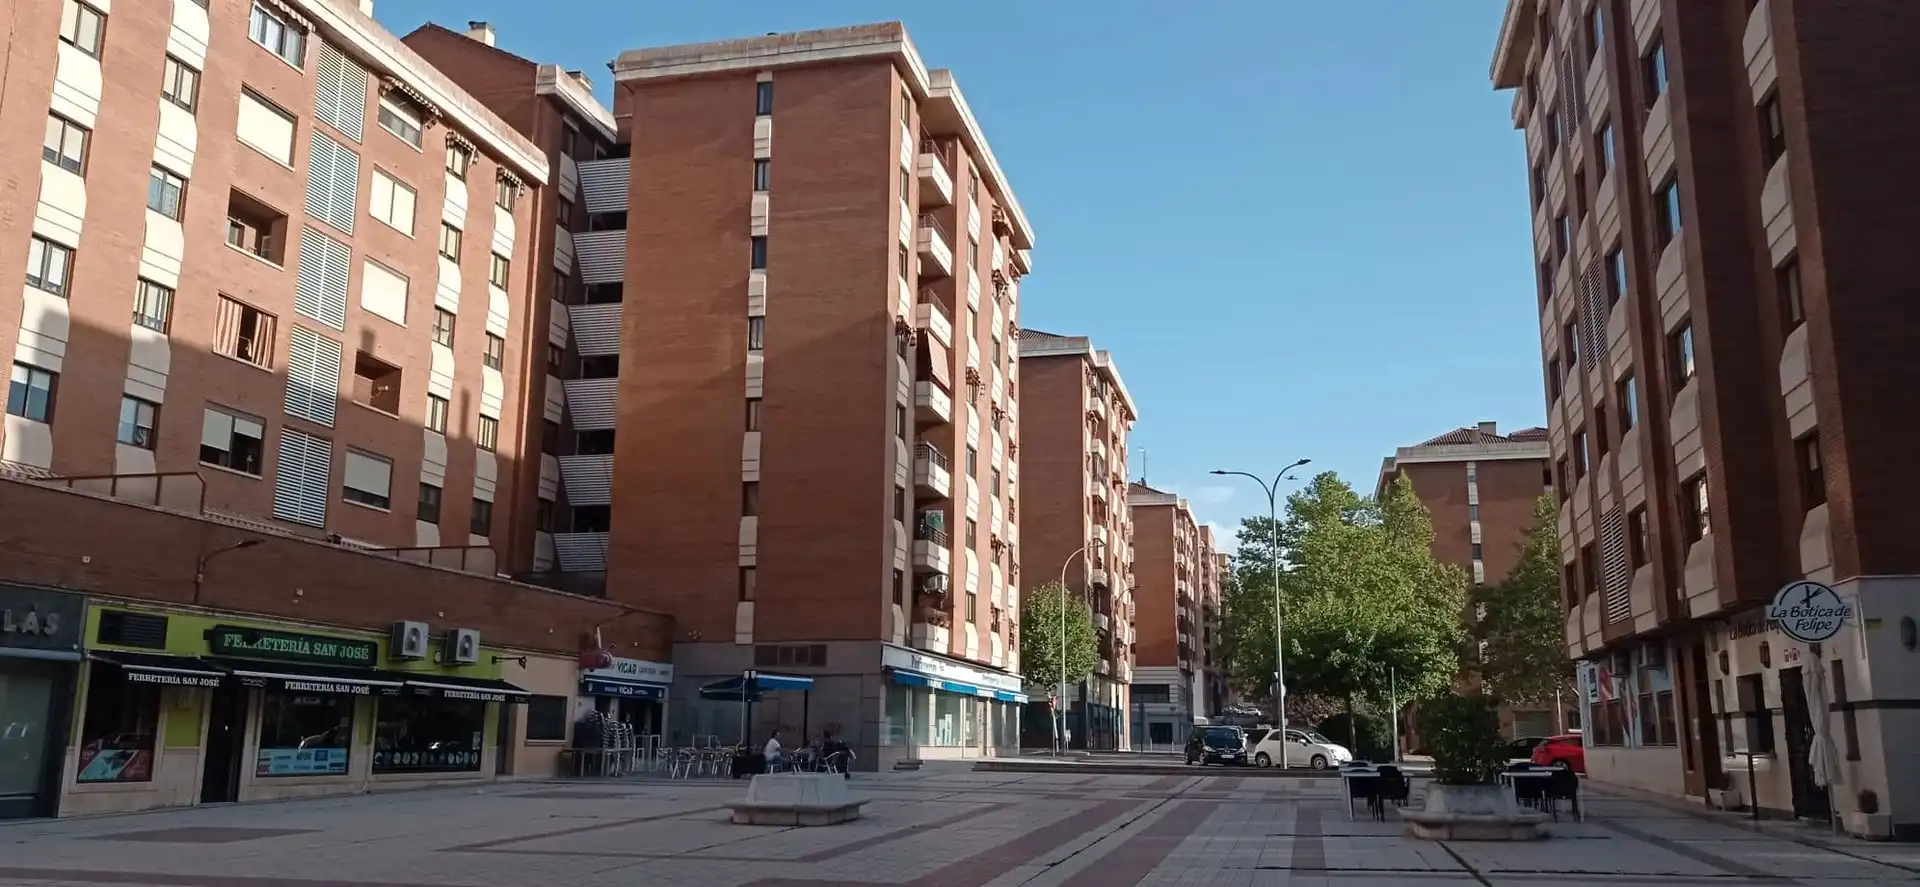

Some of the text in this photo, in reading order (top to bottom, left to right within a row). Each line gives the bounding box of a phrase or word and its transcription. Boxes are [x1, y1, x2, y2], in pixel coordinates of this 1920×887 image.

[1770, 605, 1852, 618] La Botica de
[1795, 617, 1834, 633] Felipe
[223, 633, 369, 660] FEETERÍA SAN JOSÉ
[128, 672, 220, 687] FERRETERÍA SAN JOSÉ
[284, 681, 335, 692] FERRETERÍA
[335, 684, 350, 694] SAN
[351, 684, 370, 695] JOSÉ
